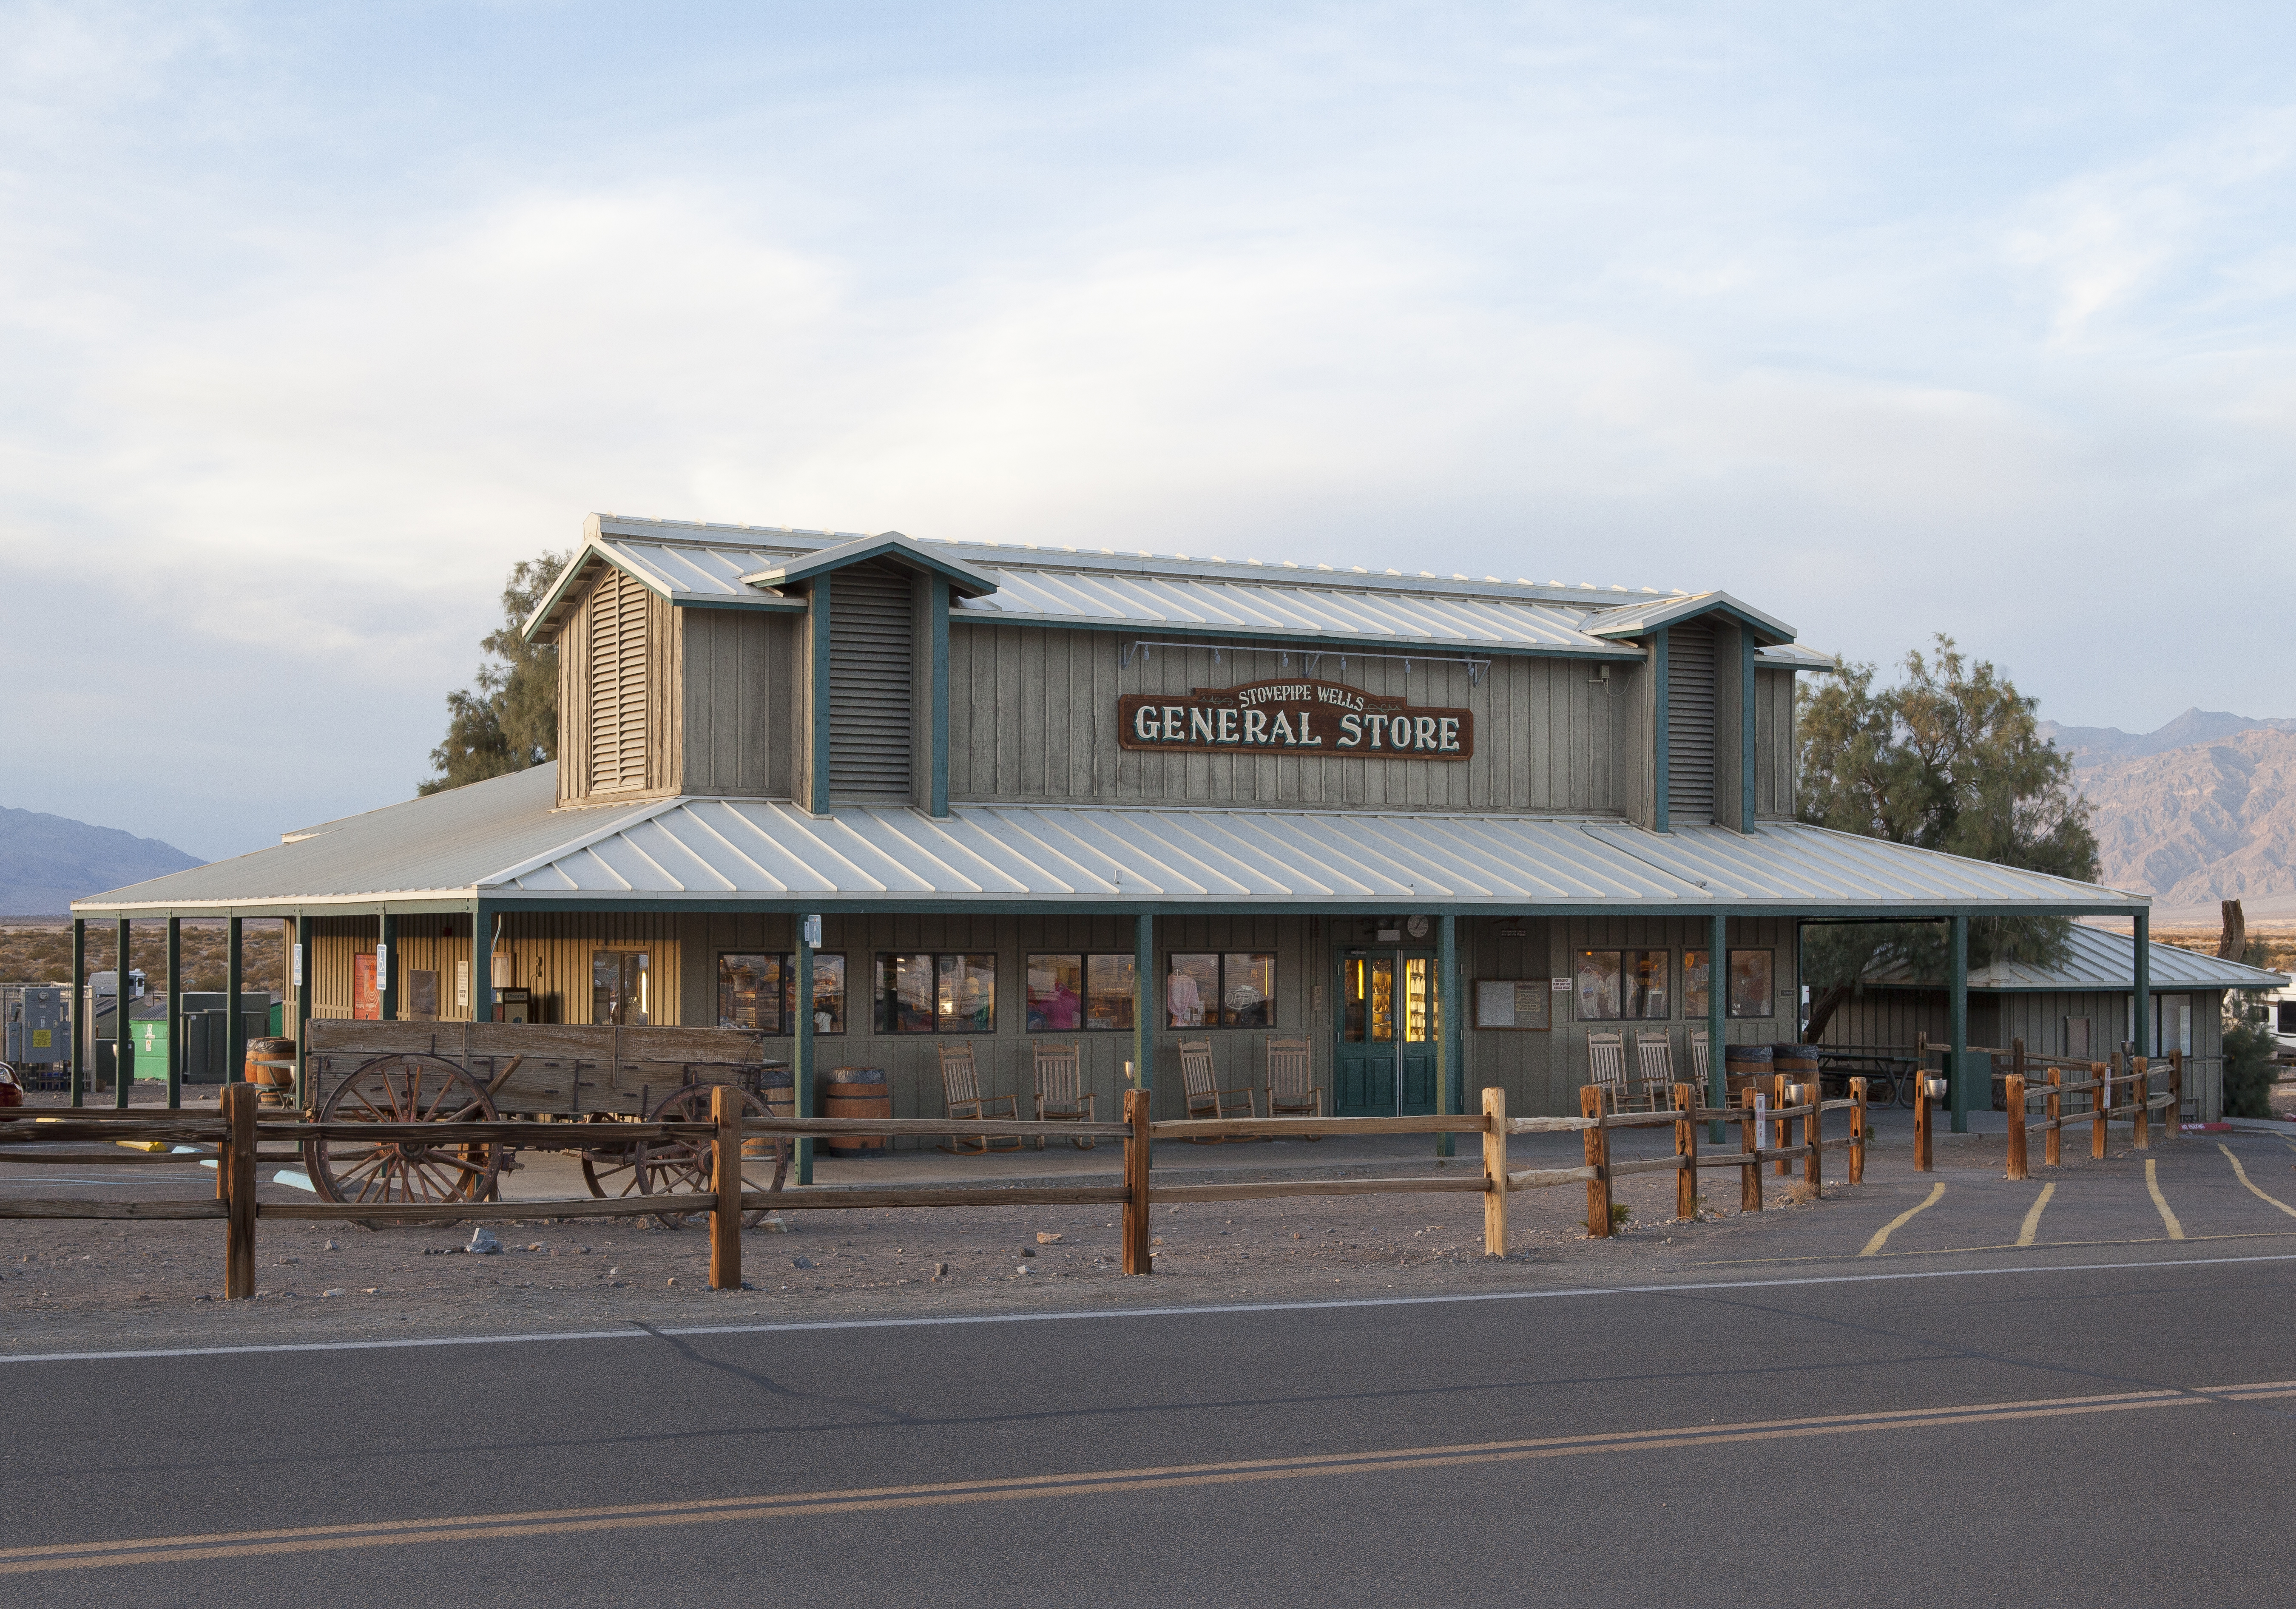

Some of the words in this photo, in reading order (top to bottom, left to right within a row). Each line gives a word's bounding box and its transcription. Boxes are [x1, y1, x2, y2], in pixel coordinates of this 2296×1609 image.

[1239, 685, 1311, 709] STOVEPIPE
[1317, 686, 1364, 711] WELLS
[1134, 706, 1321, 747] GENERAL
[1337, 714, 1460, 752] STORE
[1225, 992, 1261, 1005] OPEN
[1758, 1099, 1762, 1110] NO
